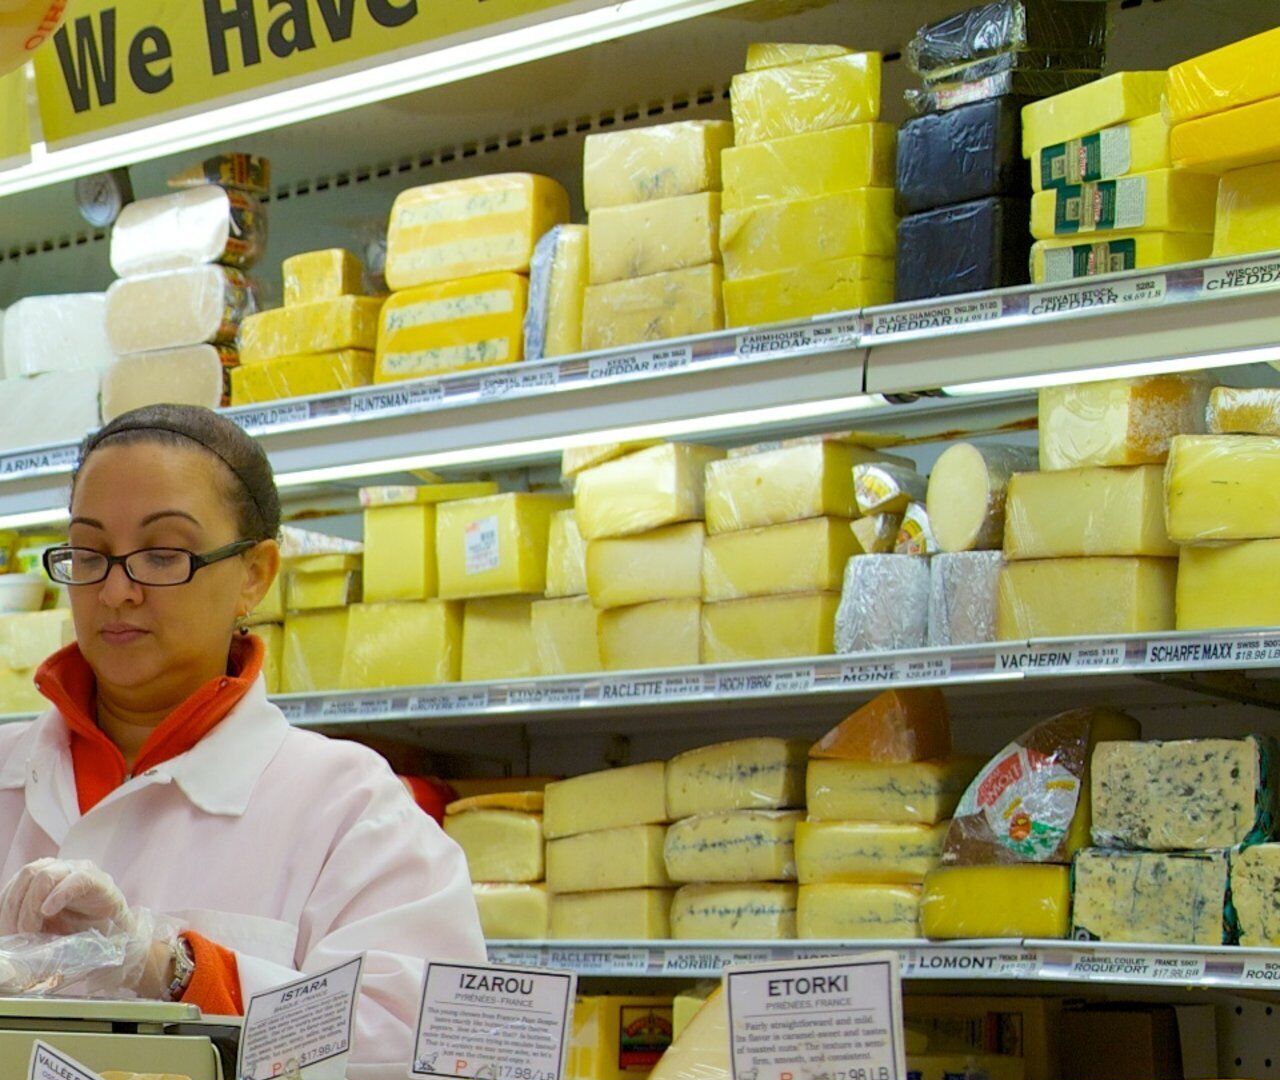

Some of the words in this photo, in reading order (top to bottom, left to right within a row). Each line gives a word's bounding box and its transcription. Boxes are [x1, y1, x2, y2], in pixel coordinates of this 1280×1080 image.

[54, 7, 173, 113] We
[1030, 294, 1118, 315] CHEDDAR
[1040, 291, 1079, 306] PRIVATE
[1082, 287, 1114, 299] STOCK
[875, 315, 952, 335] CHEDDAR
[878, 313, 908, 326] BLACK
[909, 308, 951, 322] DIAMOND
[742, 330, 806, 342] FARMHOUSE
[739, 338, 810, 354] CHEDDAR
[590, 359, 649, 379] CHEDDAR
[352, 394, 409, 412] HUNTSMAN
[5, 453, 50, 473] ARINA
[1000, 652, 1072, 668] VACHERIN
[1150, 644, 1200, 662] SCHARFE
[1202, 642, 1233, 659] MAXX
[603, 681, 662, 699] RACLETTE
[919, 956, 998, 969] LOMONT
[1074, 963, 1150, 974] ROQUEFORT
[1114, 957, 1146, 965] COULET
[280, 977, 329, 1003] ISTARA
[459, 973, 534, 995] IZAROU
[769, 975, 848, 997] ETORKI
[501, 997, 534, 1008] FRANCE
[815, 998, 852, 1007] FRANCE
[748, 1033, 770, 1042] flavor
[844, 1028, 860, 1037] and
[862, 1027, 887, 1036] tastes
[746, 1045, 776, 1054] toasted
[822, 1040, 852, 1049] texture
[456, 1060, 468, 1074] P
[809, 1054, 825, 1062] and
